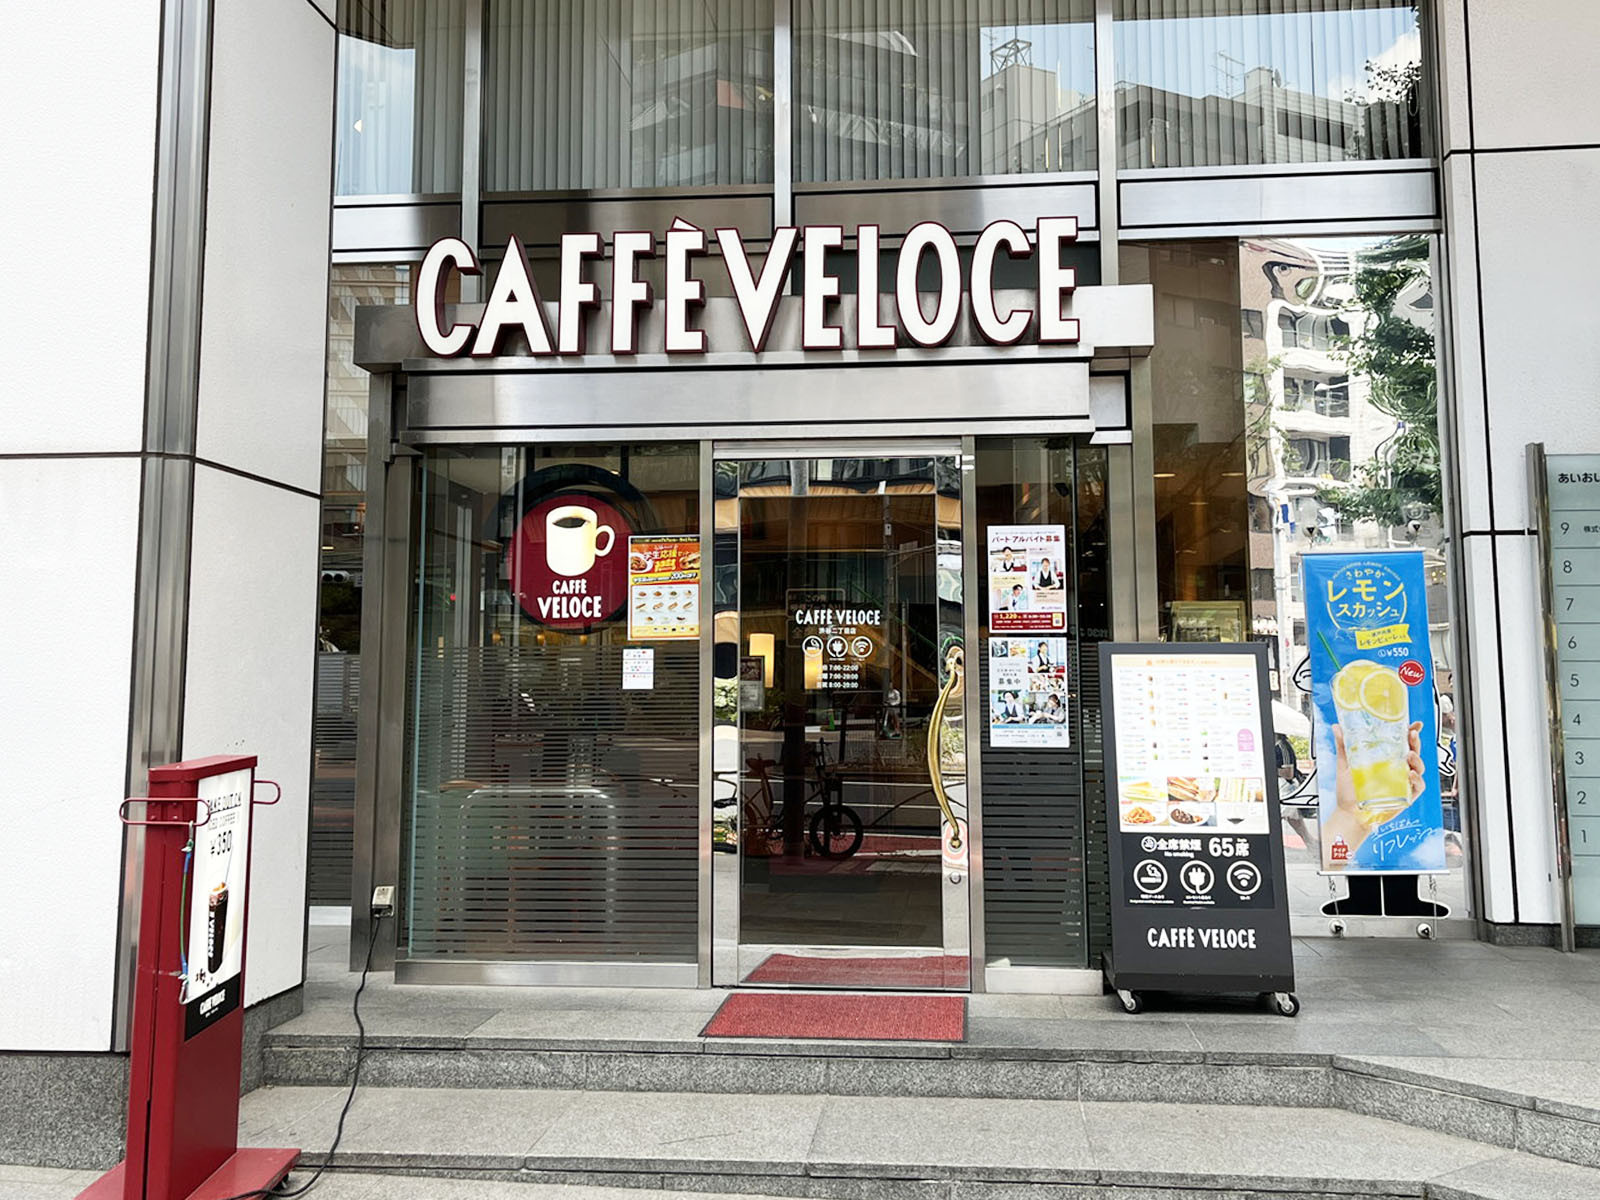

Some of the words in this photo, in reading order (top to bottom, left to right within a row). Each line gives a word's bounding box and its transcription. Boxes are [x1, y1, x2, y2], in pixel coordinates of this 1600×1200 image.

[415, 216, 708, 358] CAFFÈ
[714, 215, 1080, 354] VELOCE
[1560, 522, 1570, 536] 9
[1563, 560, 1573, 574] 8
[552, 578, 587, 595] CAFFÈ
[1327, 579, 1404, 602] レモン
[537, 596, 602, 619] VELOCE
[1336, 602, 1401, 618] スカッシュ
[1565, 597, 1574, 611] 7
[795, 608, 832, 626] CAFFÈ
[836, 610, 881, 626] VELOCE
[1567, 636, 1577, 650] 6
[1399, 665, 1423, 679] New
[1569, 674, 1580, 687] 5
[1572, 713, 1582, 726] 4
[1574, 752, 1585, 765] 3
[1577, 791, 1587, 805] 2
[210, 829, 233, 856] ¥350
[1580, 830, 1587, 843] 1
[1208, 837, 1250, 857] 65席
[1147, 926, 1195, 948] CAFFÈ
[1198, 928, 1256, 949] VELOCE
